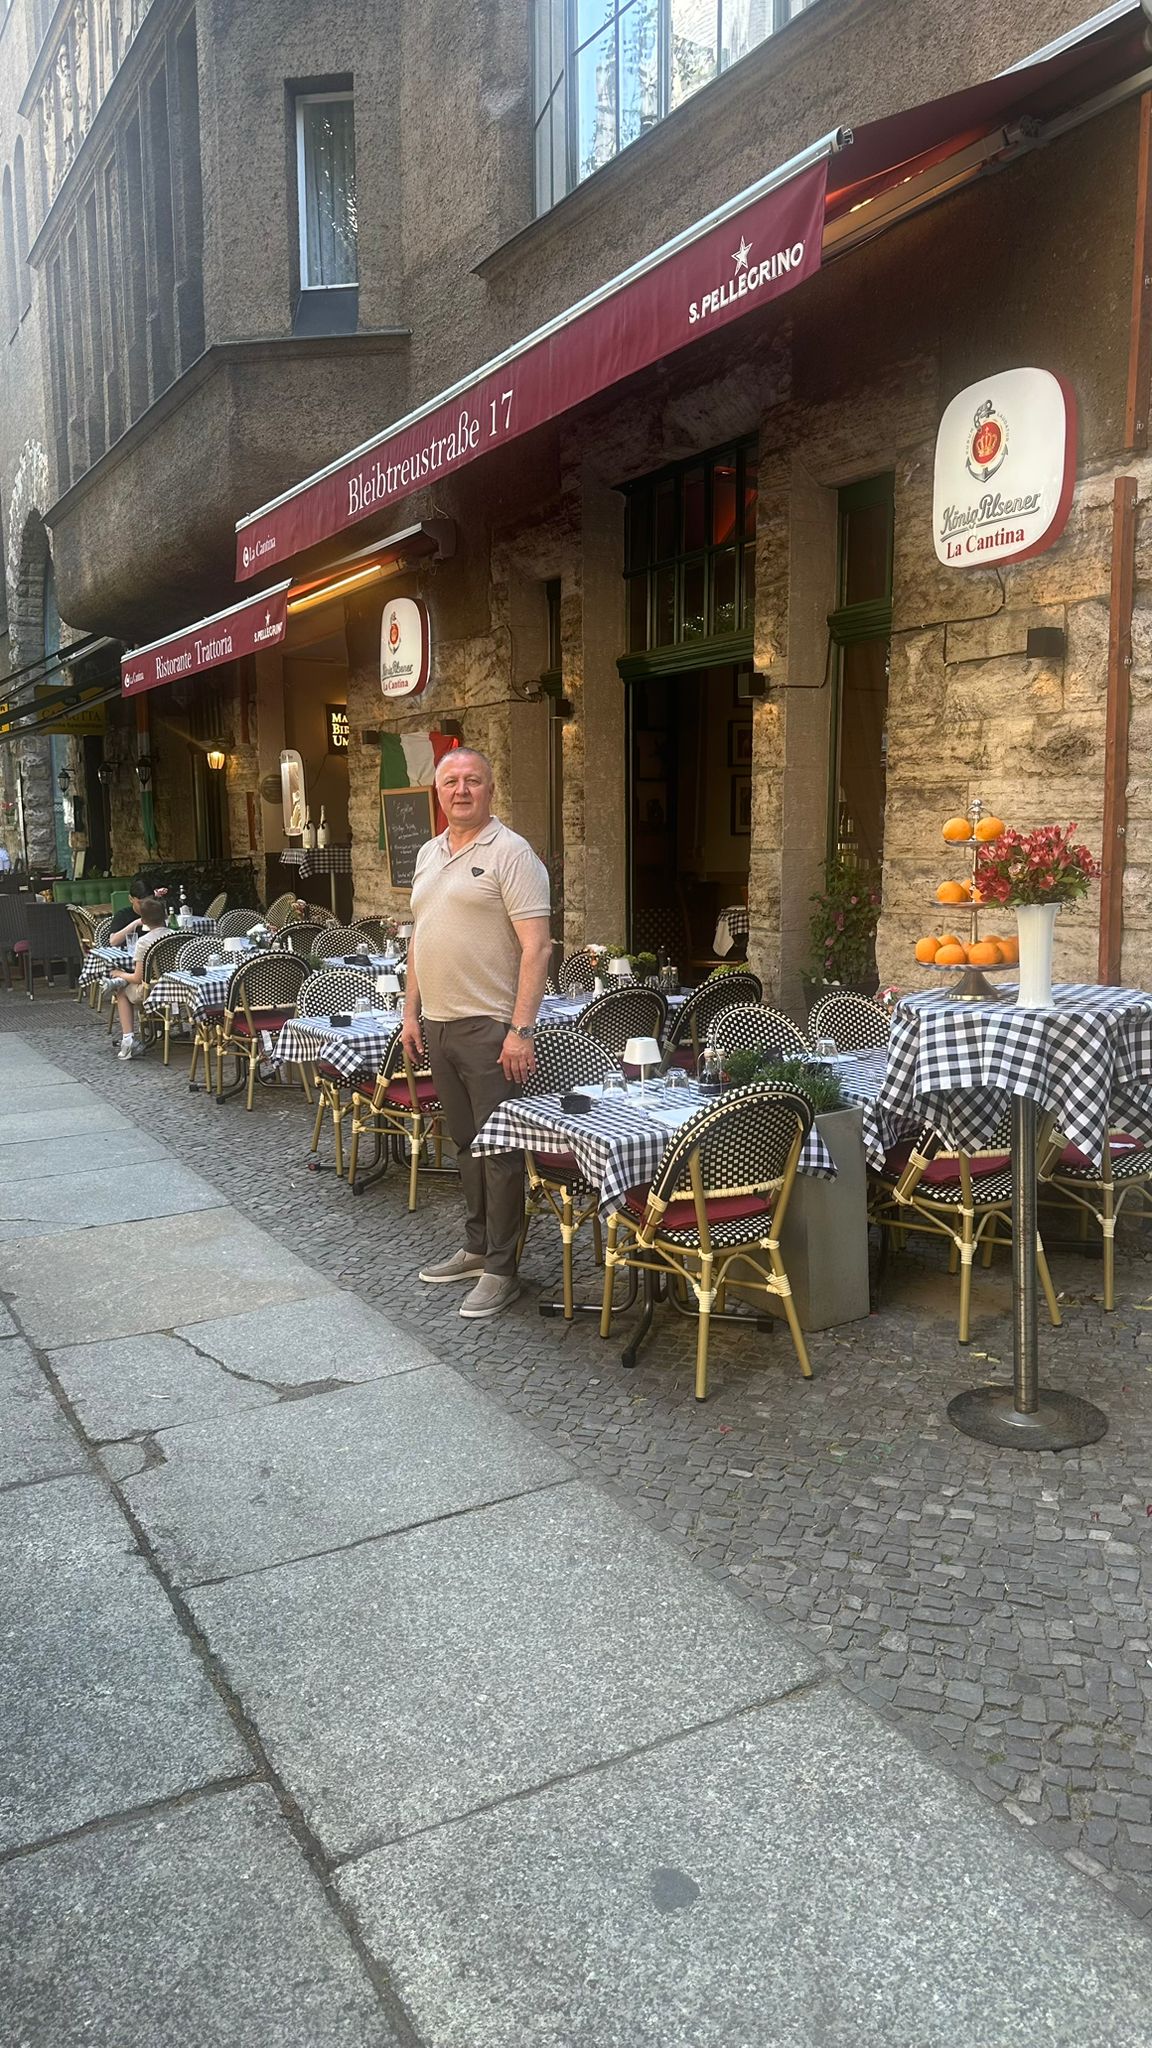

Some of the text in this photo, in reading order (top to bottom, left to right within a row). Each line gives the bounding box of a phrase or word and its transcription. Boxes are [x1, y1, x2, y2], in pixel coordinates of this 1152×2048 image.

[348, 389, 514, 516] Bleibtreustraße 17
[940, 493, 1041, 534] König Pilsener
[946, 527, 1025, 560] La Cantina
[155, 628, 233, 680] Ristorante Trattoria
